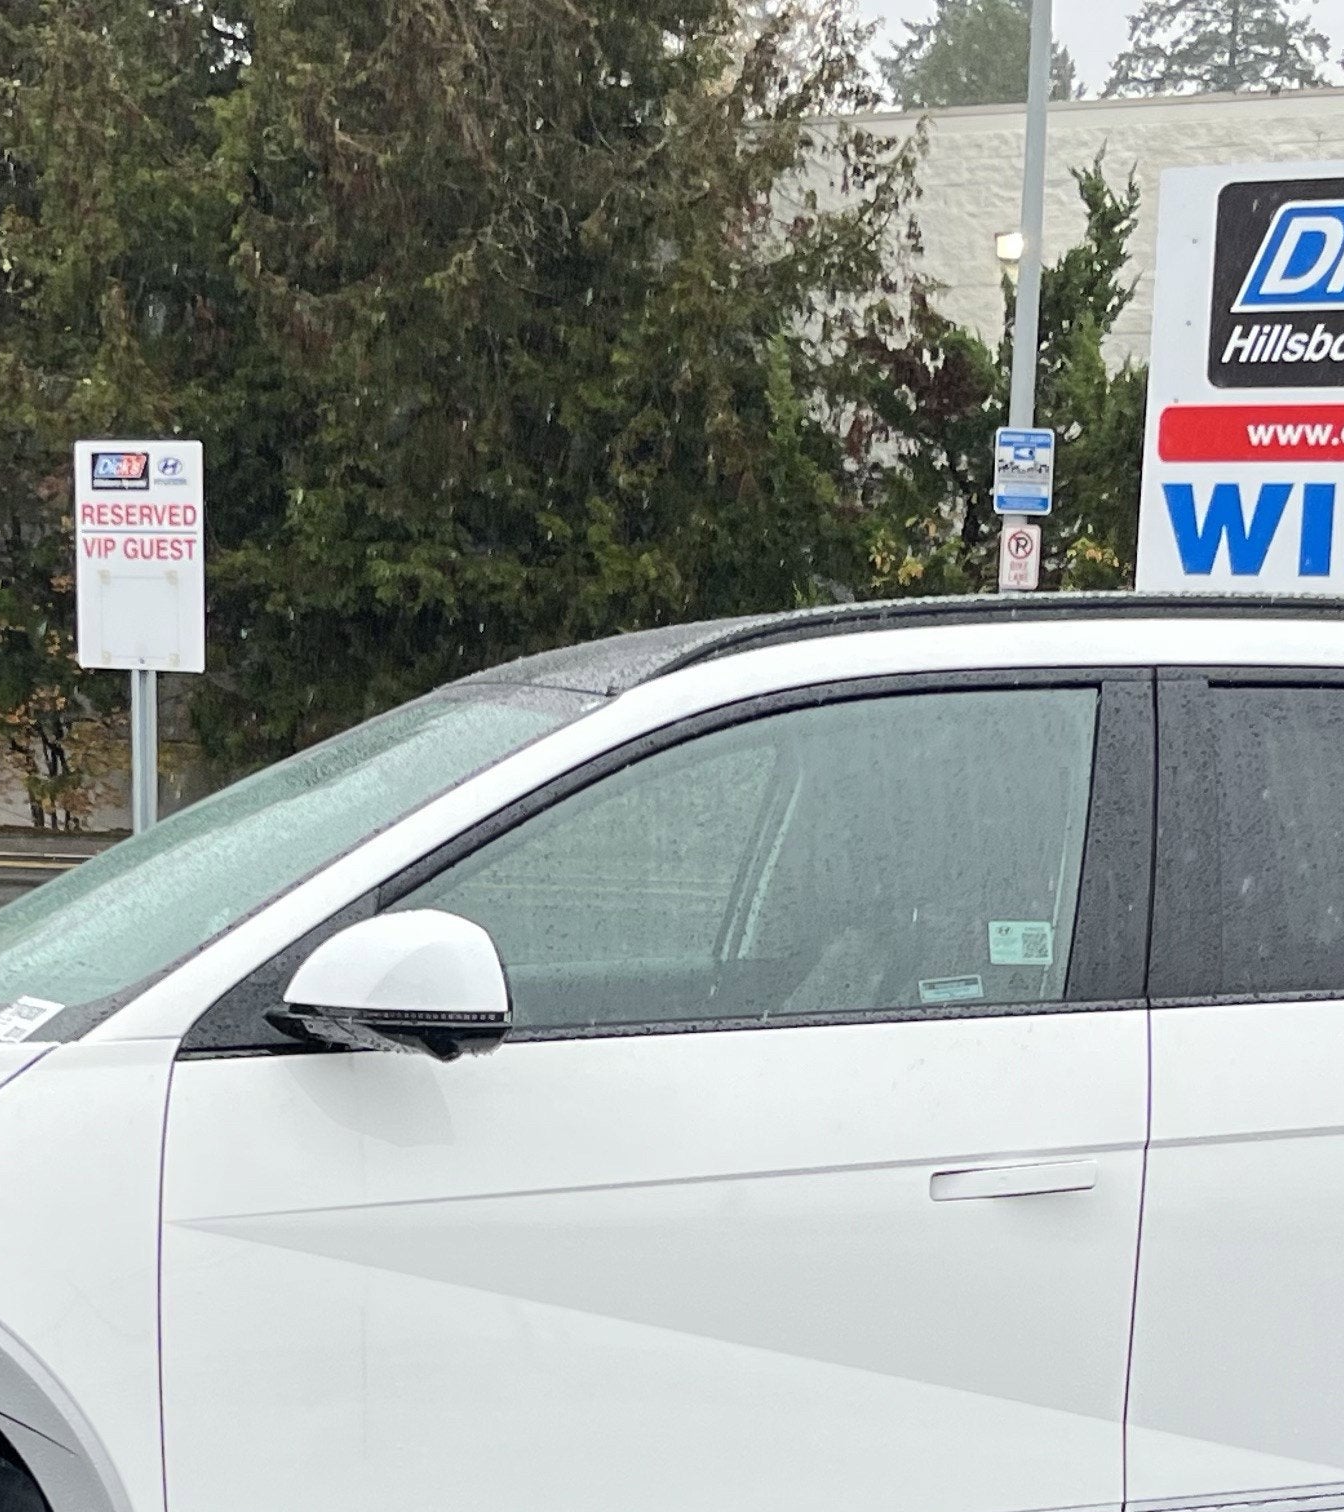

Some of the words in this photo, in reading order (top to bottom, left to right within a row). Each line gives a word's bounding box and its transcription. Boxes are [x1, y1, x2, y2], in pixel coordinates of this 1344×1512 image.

[81, 503, 197, 526] RESERVED
[82, 537, 116, 559] VIP
[123, 538, 197, 561] GUEST
